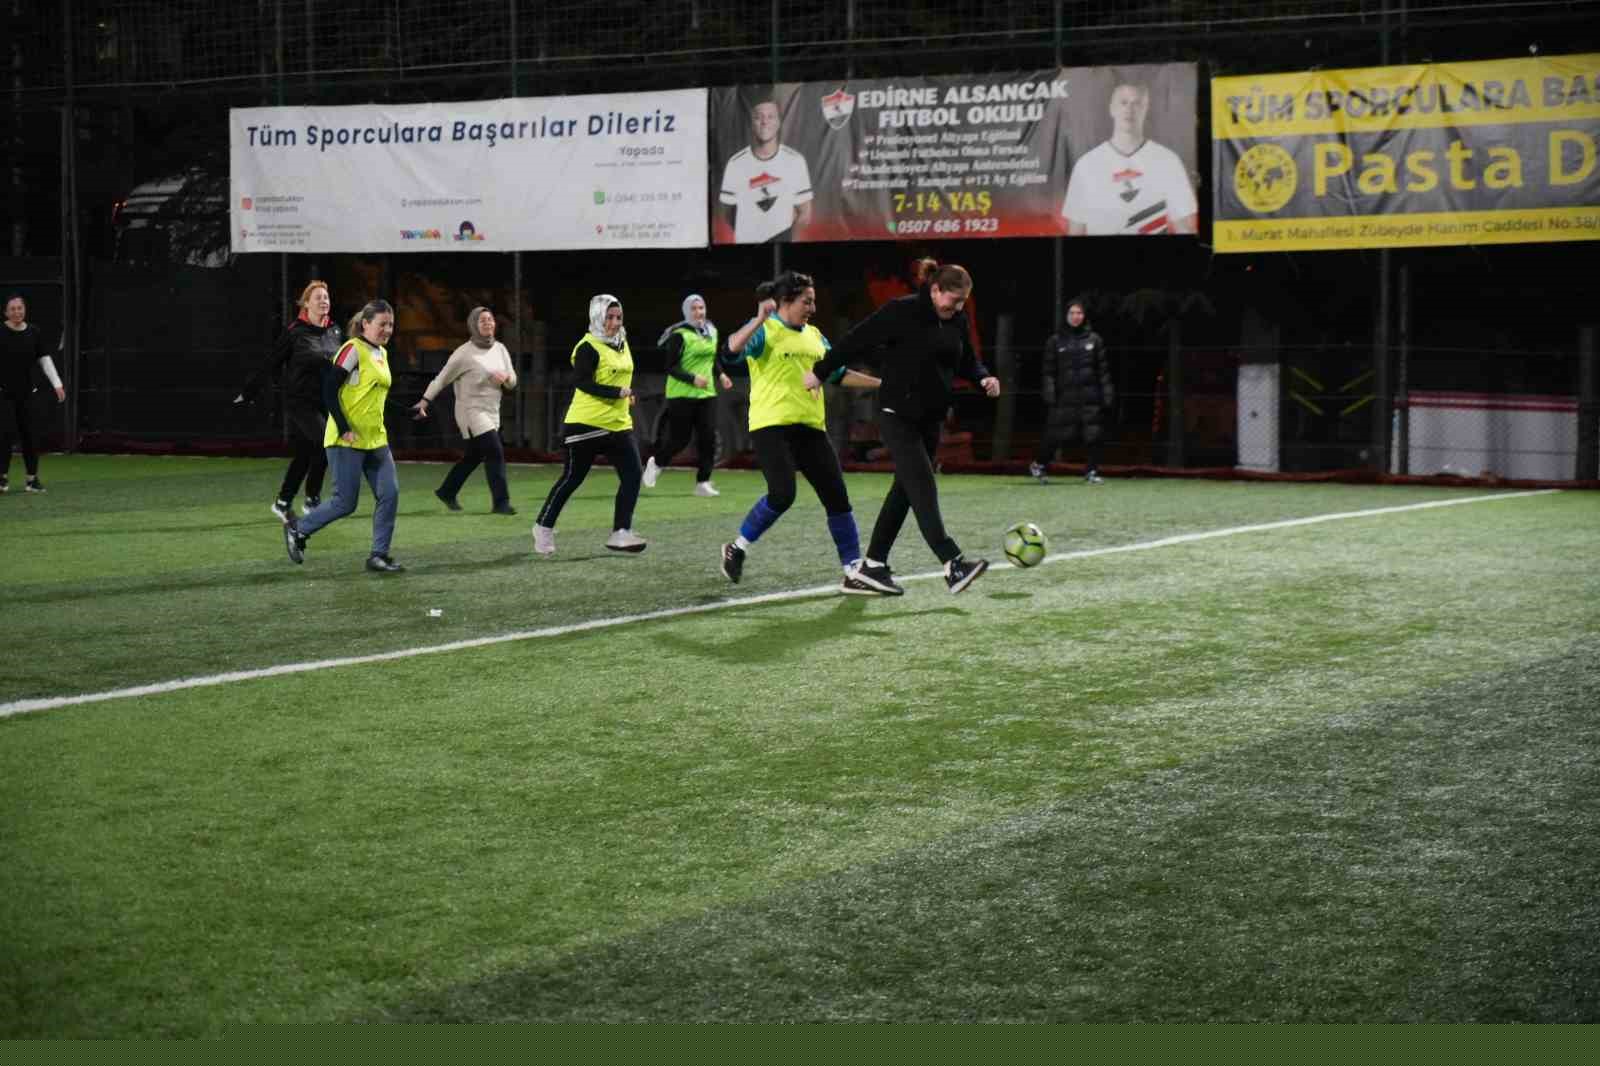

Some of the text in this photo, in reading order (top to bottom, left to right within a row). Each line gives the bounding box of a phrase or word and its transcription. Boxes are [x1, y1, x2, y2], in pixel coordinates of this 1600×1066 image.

[857, 80, 1069, 109] EDİRNE ALSANCAK
[1226, 86, 1293, 124] TÜM
[1304, 79, 1531, 119] SPORCULARA
[879, 103, 1044, 129] FUTBOL OKULU
[247, 109, 676, 152] Tüm Sporculara Başarılar Dileriz
[619, 145, 664, 157] Yapada
[1313, 139, 1523, 198] Pasta
[893, 191, 993, 216] 7-14 YAŞ
[897, 218, 999, 233] 0507 686 1923
[1241, 227, 1282, 240] Murat
[1287, 225, 1354, 240] Mahallesi
[1359, 222, 1424, 239] Zübeyde
[1427, 221, 1478, 235] Hanım
[1482, 217, 1543, 232] Caddesi
